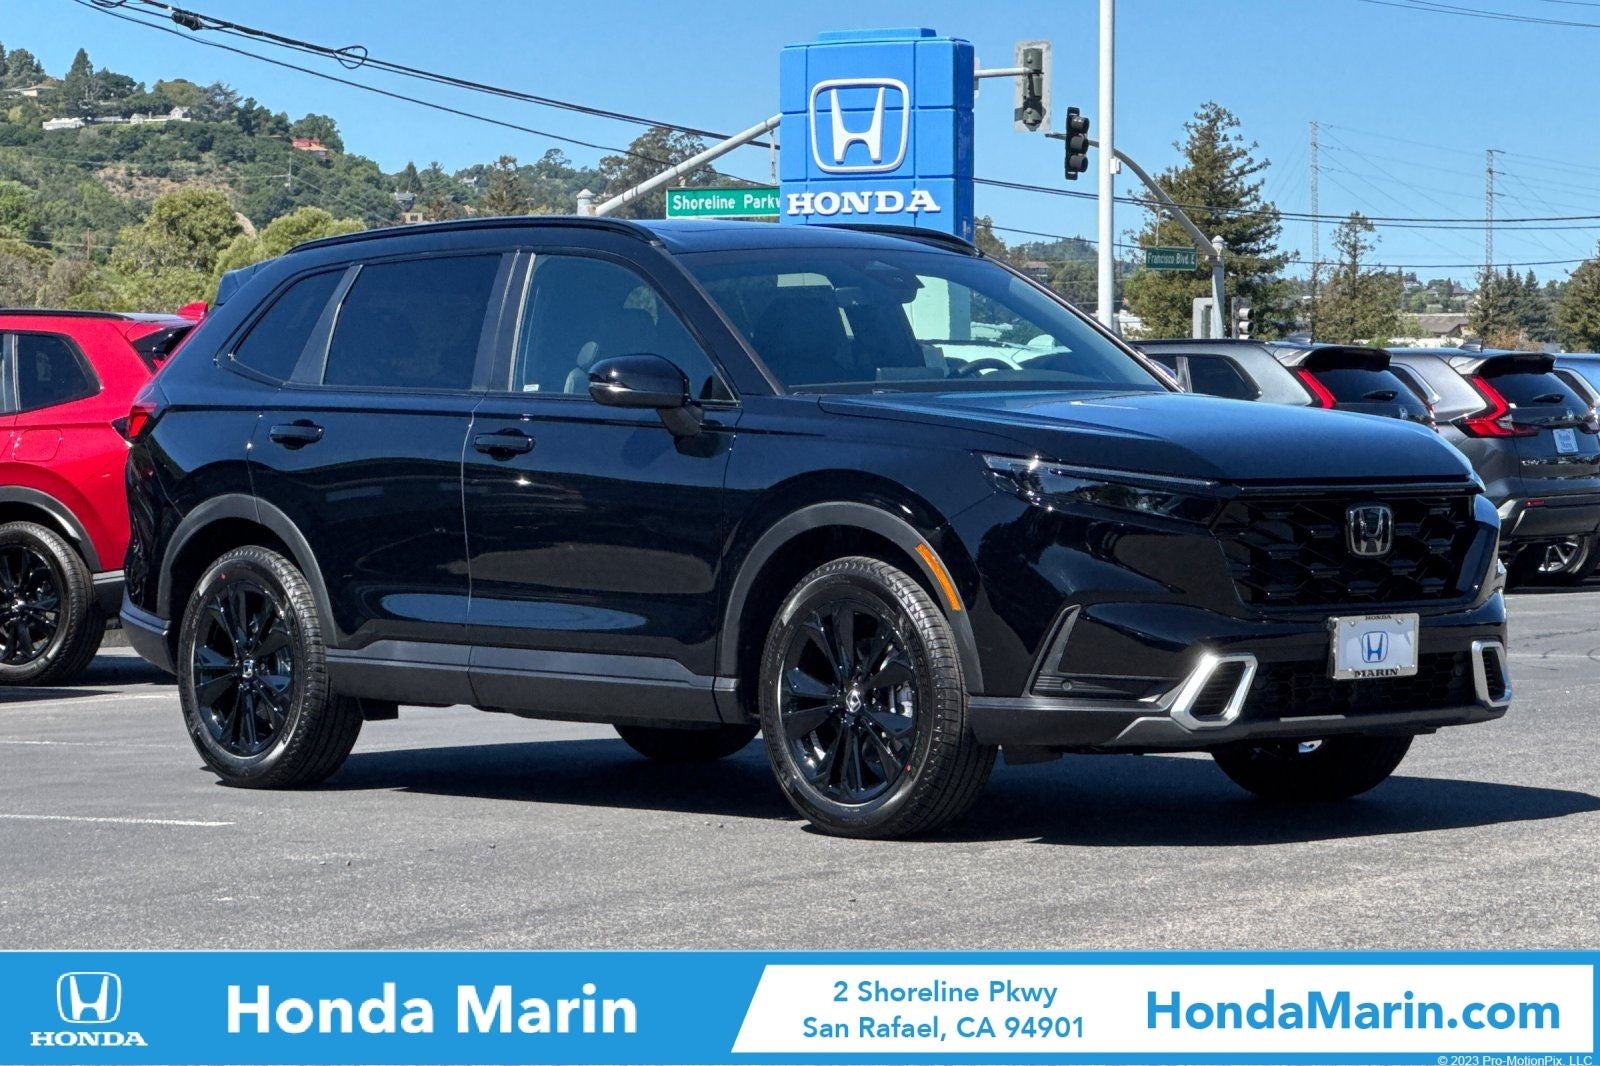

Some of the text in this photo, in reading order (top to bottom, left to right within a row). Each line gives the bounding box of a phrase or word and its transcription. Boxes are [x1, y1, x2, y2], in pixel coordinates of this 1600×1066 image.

[672, 194, 736, 210] Shoreline
[786, 190, 941, 216] HONDA
[1147, 252, 1175, 264] Francisco
[1354, 668, 1398, 678] MARIN
